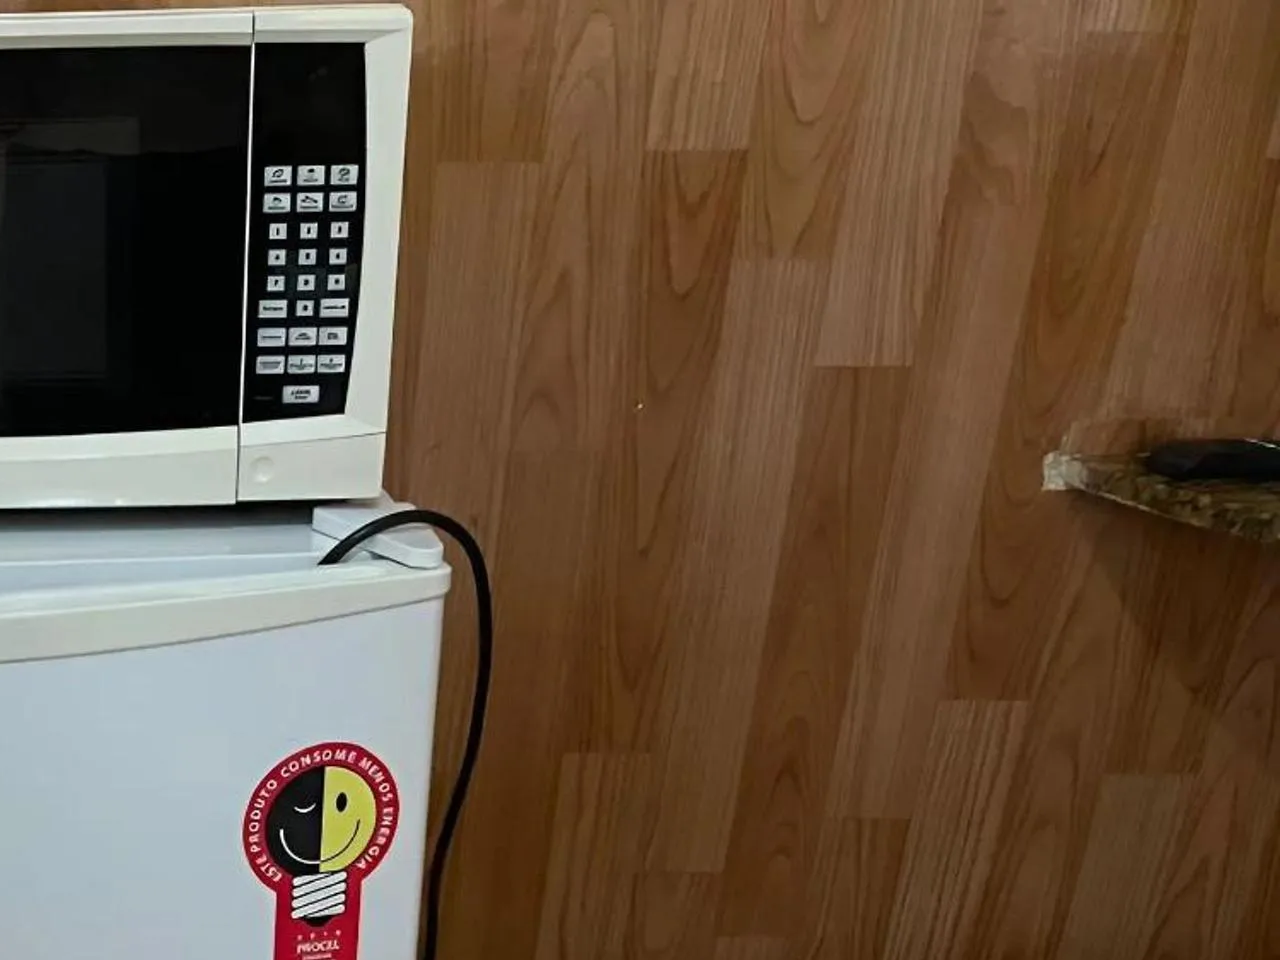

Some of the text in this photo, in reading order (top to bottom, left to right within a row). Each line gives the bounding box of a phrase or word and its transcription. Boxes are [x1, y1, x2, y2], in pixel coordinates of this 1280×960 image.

[248, 748, 395, 882] ESTE PRODUTO CONSOME MENOS ENERGIA
